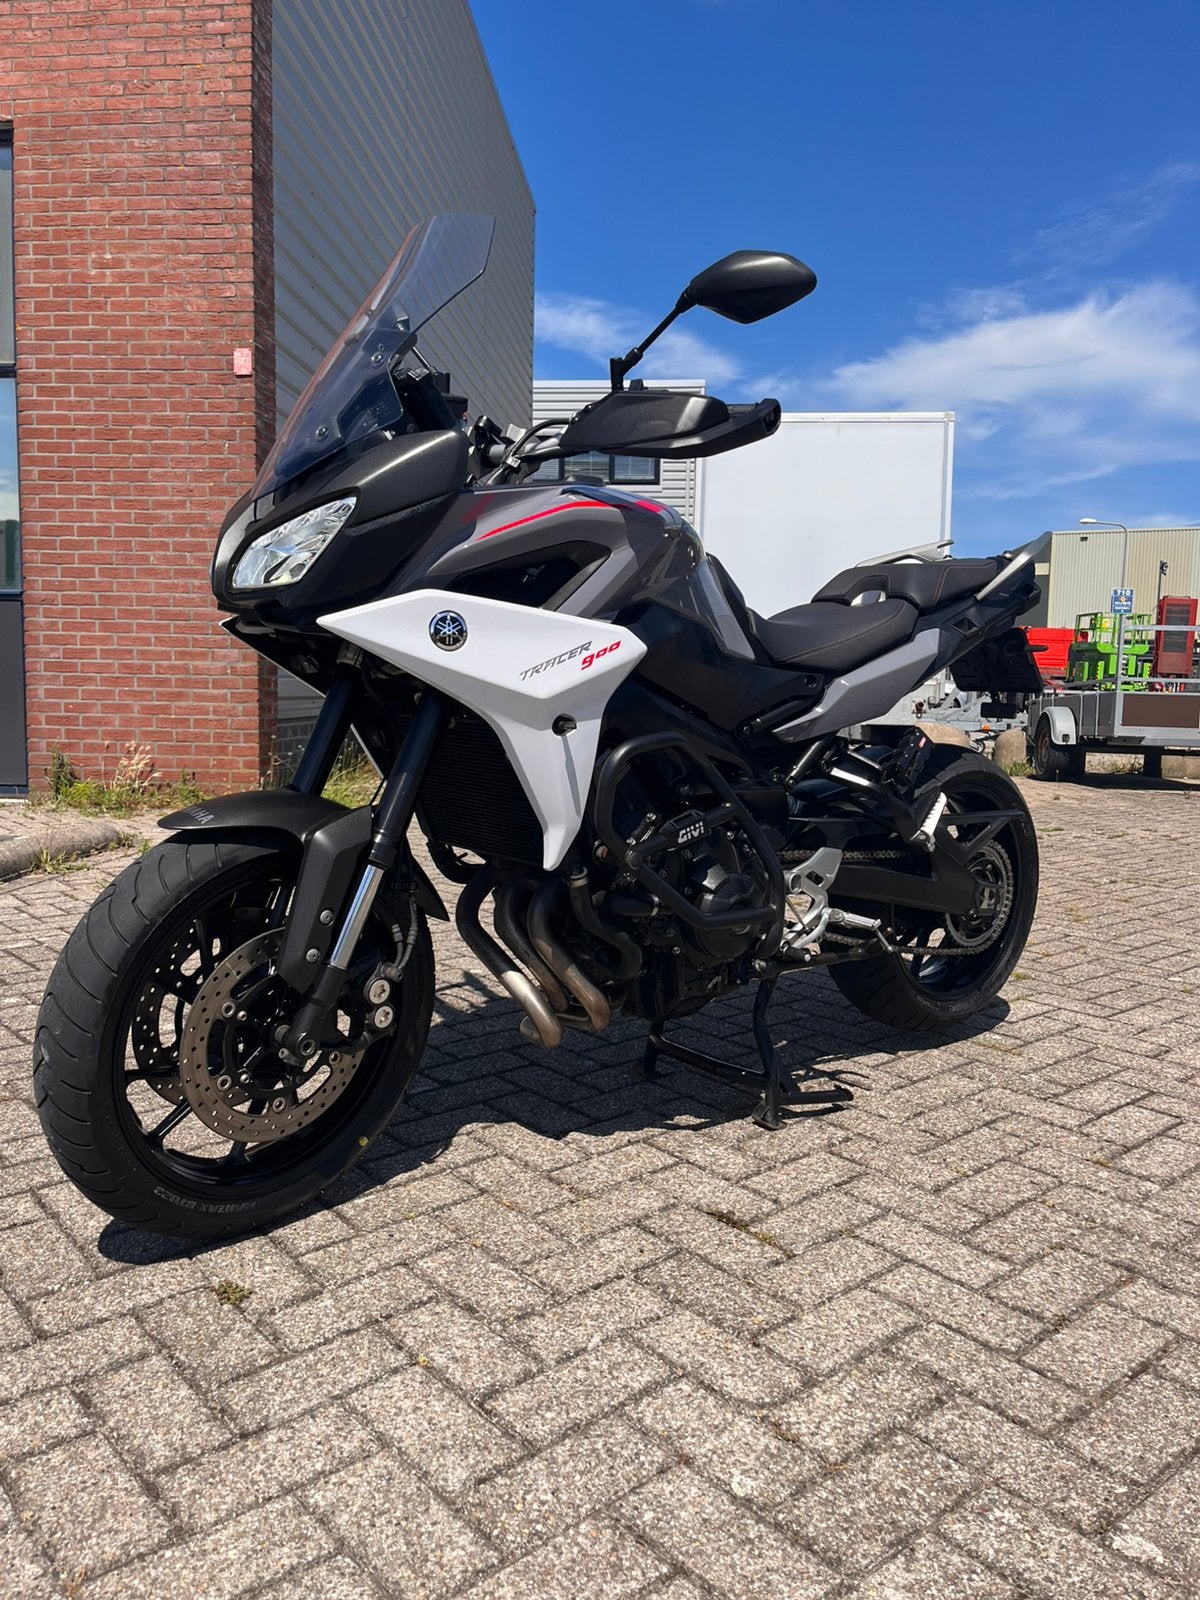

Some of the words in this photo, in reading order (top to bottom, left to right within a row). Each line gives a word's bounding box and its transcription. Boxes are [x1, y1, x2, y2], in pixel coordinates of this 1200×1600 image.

[519, 640, 592, 681] TRACER
[580, 640, 621, 671] 900
[678, 821, 704, 843] GIVI
